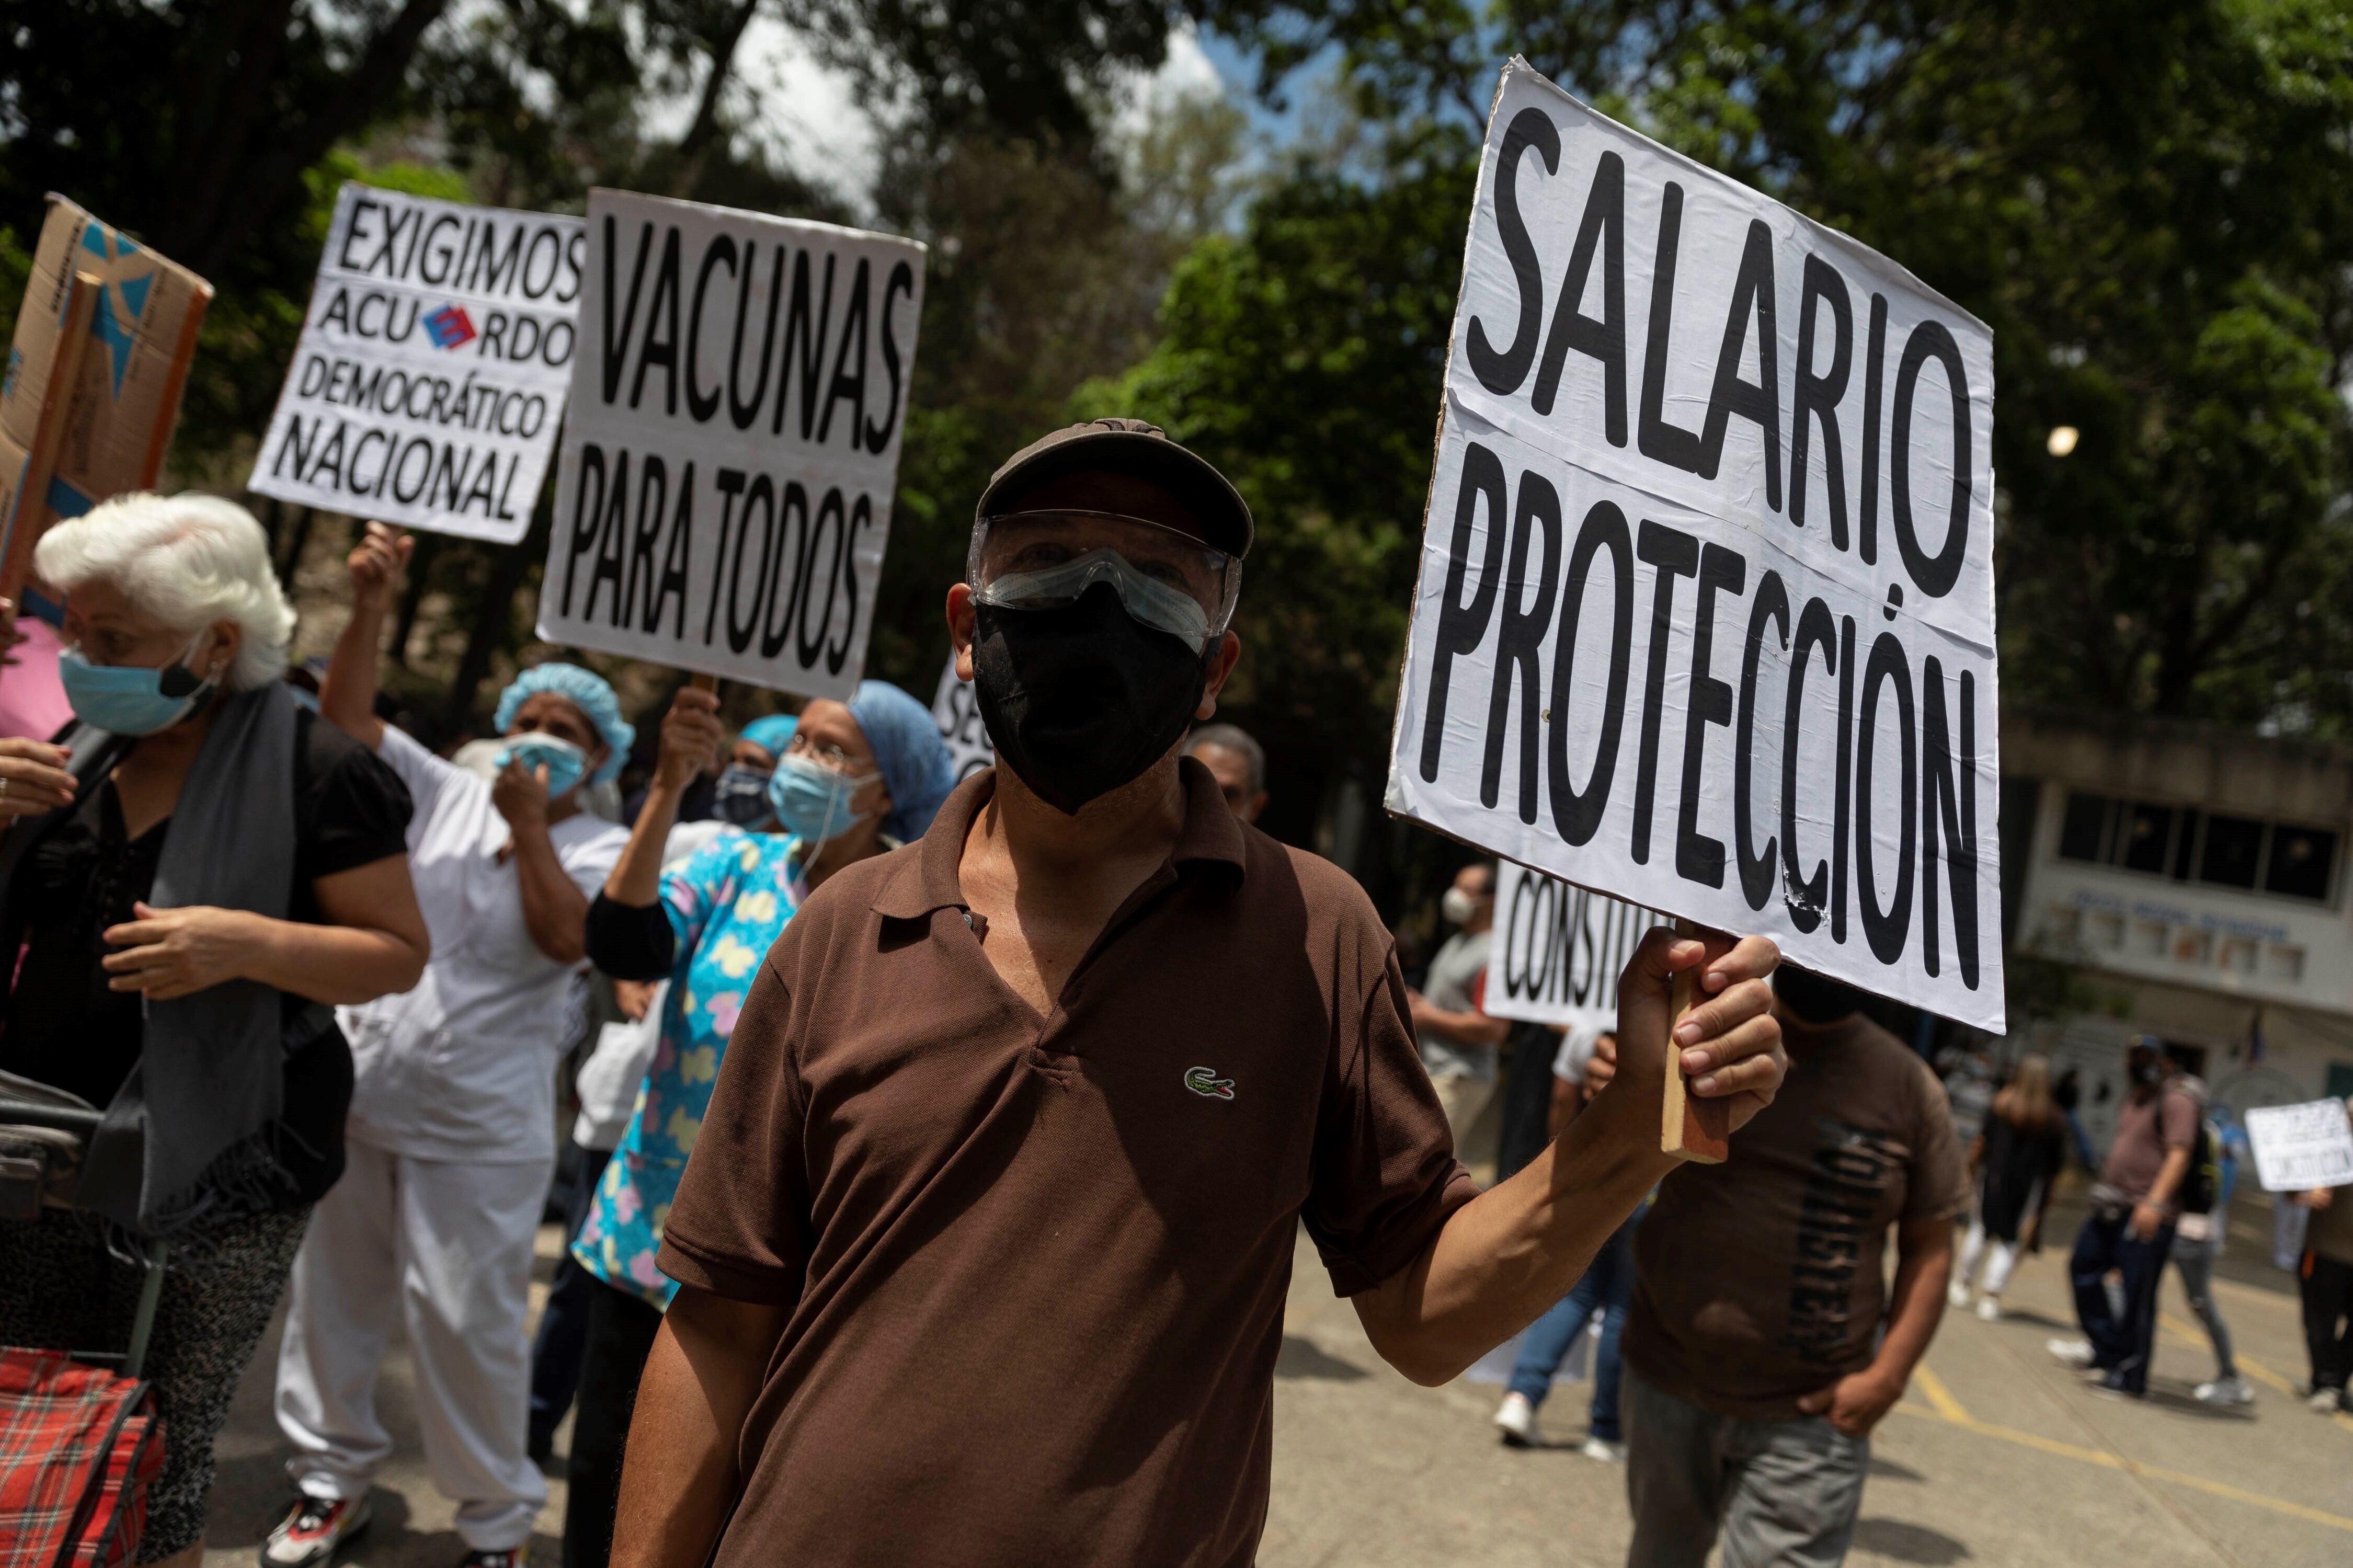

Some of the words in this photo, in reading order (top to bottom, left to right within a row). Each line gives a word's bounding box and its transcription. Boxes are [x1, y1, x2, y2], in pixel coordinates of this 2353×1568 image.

[340, 200, 586, 303] EXIGIMOS
[603, 216, 913, 454] VACUNAS
[1465, 107, 1971, 598] SALARIO
[272, 415, 519, 521] NACIONAL
[300, 356, 546, 438] DEMOCRÁTICO
[562, 444, 694, 640] PARA
[705, 467, 870, 675] TODOS
[1420, 441, 1979, 991] PROTECCIÓN
